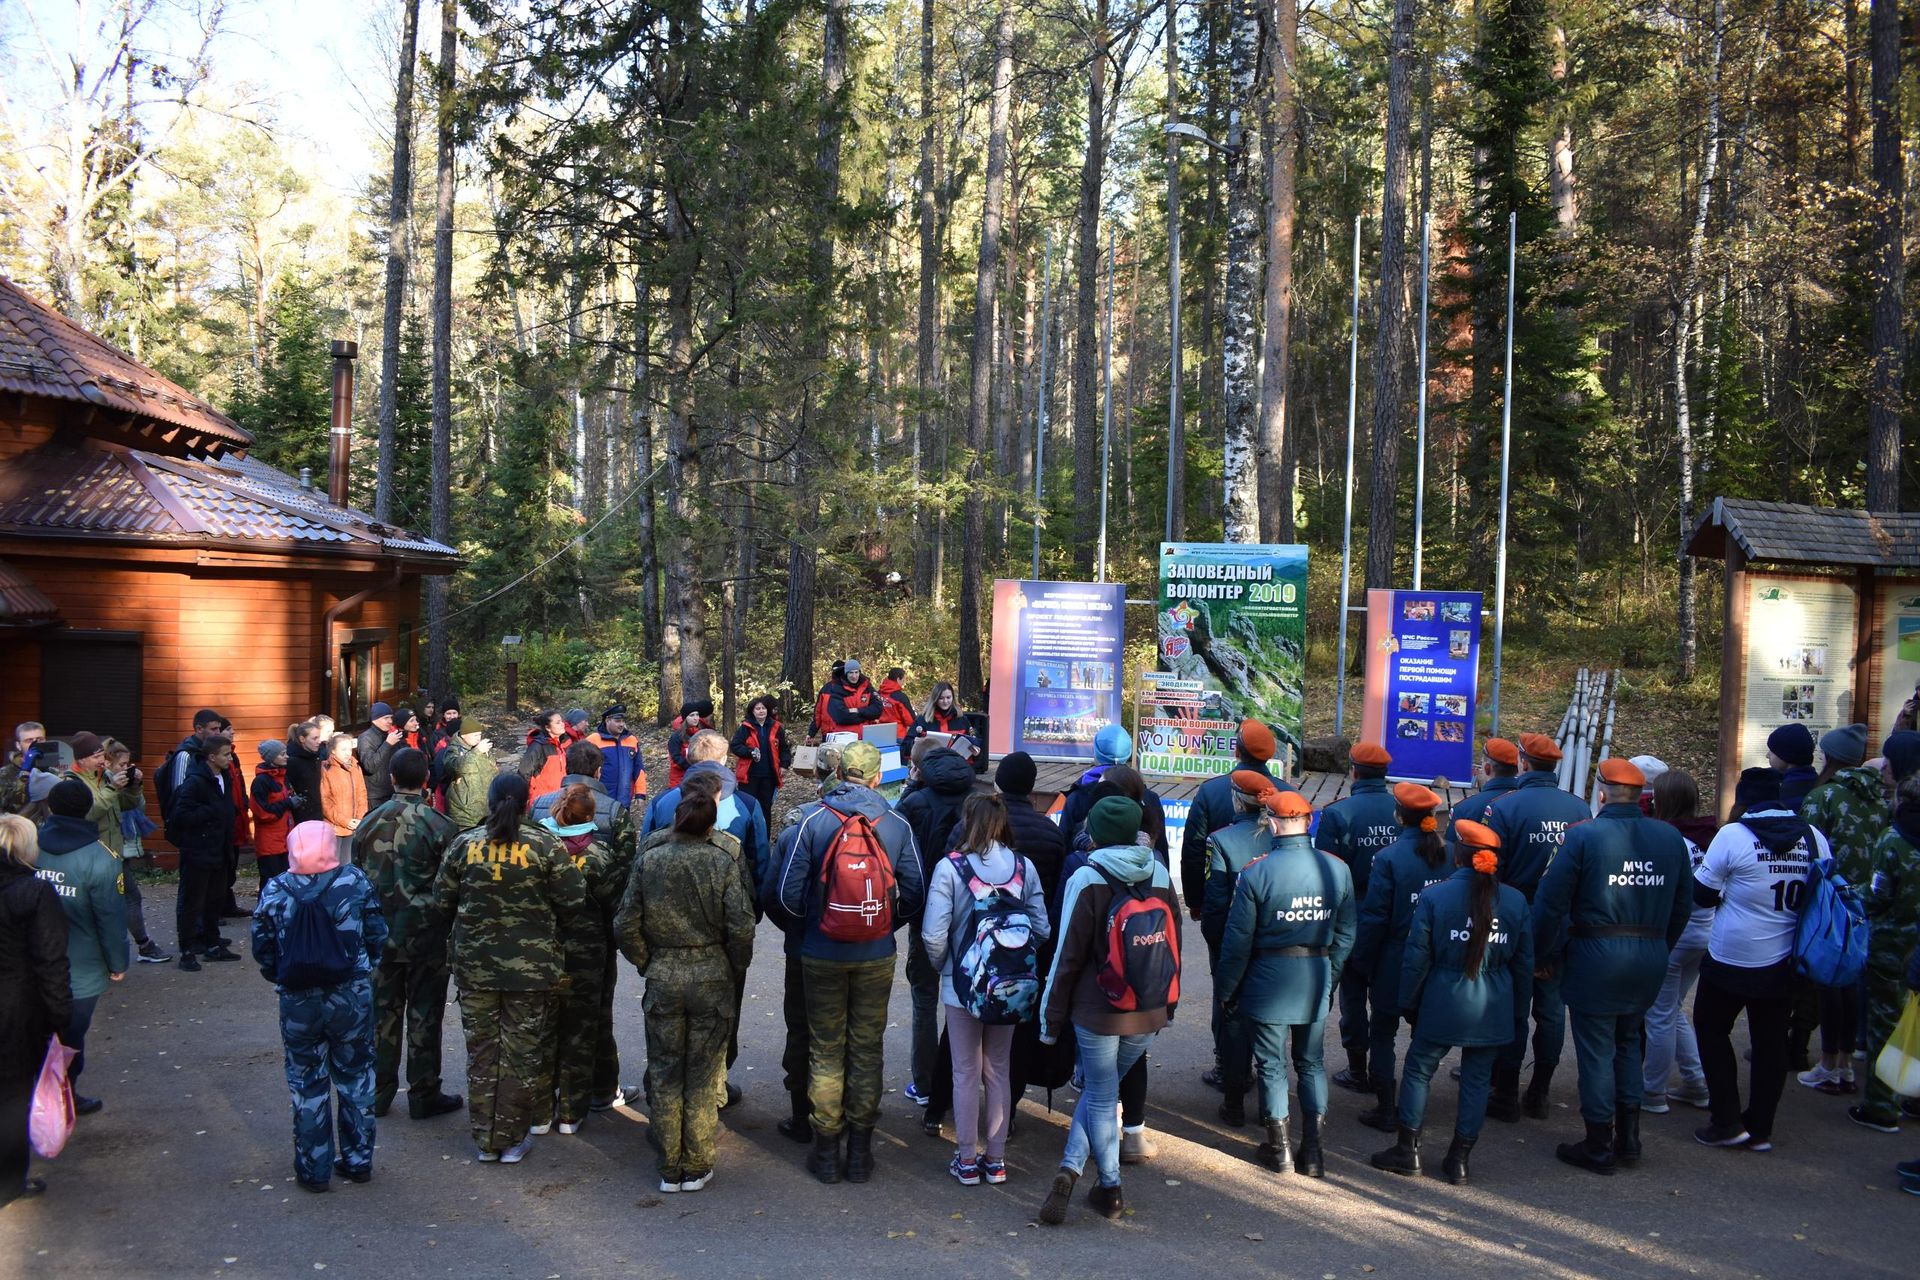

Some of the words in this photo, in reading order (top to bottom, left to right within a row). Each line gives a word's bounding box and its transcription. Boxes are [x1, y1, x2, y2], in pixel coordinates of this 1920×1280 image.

[1167, 563, 1272, 581] ЗАПОВЕДНЫЙ
[1166, 584, 1243, 599] ВОЛОНТЕР
[1249, 583, 1296, 603] 2019
[1400, 657, 1434, 665] ОКАЗАНИЕ
[1426, 667, 1457, 675] ПОМОЩИ
[1399, 674, 1453, 683] ПОСТРАДАВШИМ
[1141, 717, 1187, 728] ПОЧЕТНЫЙ
[1189, 721, 1236, 729] ВОЛОНТЕР!
[1140, 732, 1237, 750] VOLUNTEE
[1142, 754, 1169, 772] ГОД
[1368, 826, 1395, 836] МЧС
[1358, 836, 1397, 847] РОССИ
[1529, 832, 1562, 843] РОСС
[1757, 852, 1809, 863] МЕДИЦИНСК
[492, 863, 502, 880] 1
[1623, 861, 1653, 872] МЧС
[1768, 864, 1808, 874] ТЕХНИКУМ
[1608, 874, 1665, 886] РОССИИ
[1770, 879, 1805, 911] 10
[1291, 896, 1322, 908] МЧС
[1276, 909, 1331, 921] РОССИИ
[1450, 930, 1507, 943] РОИИ
